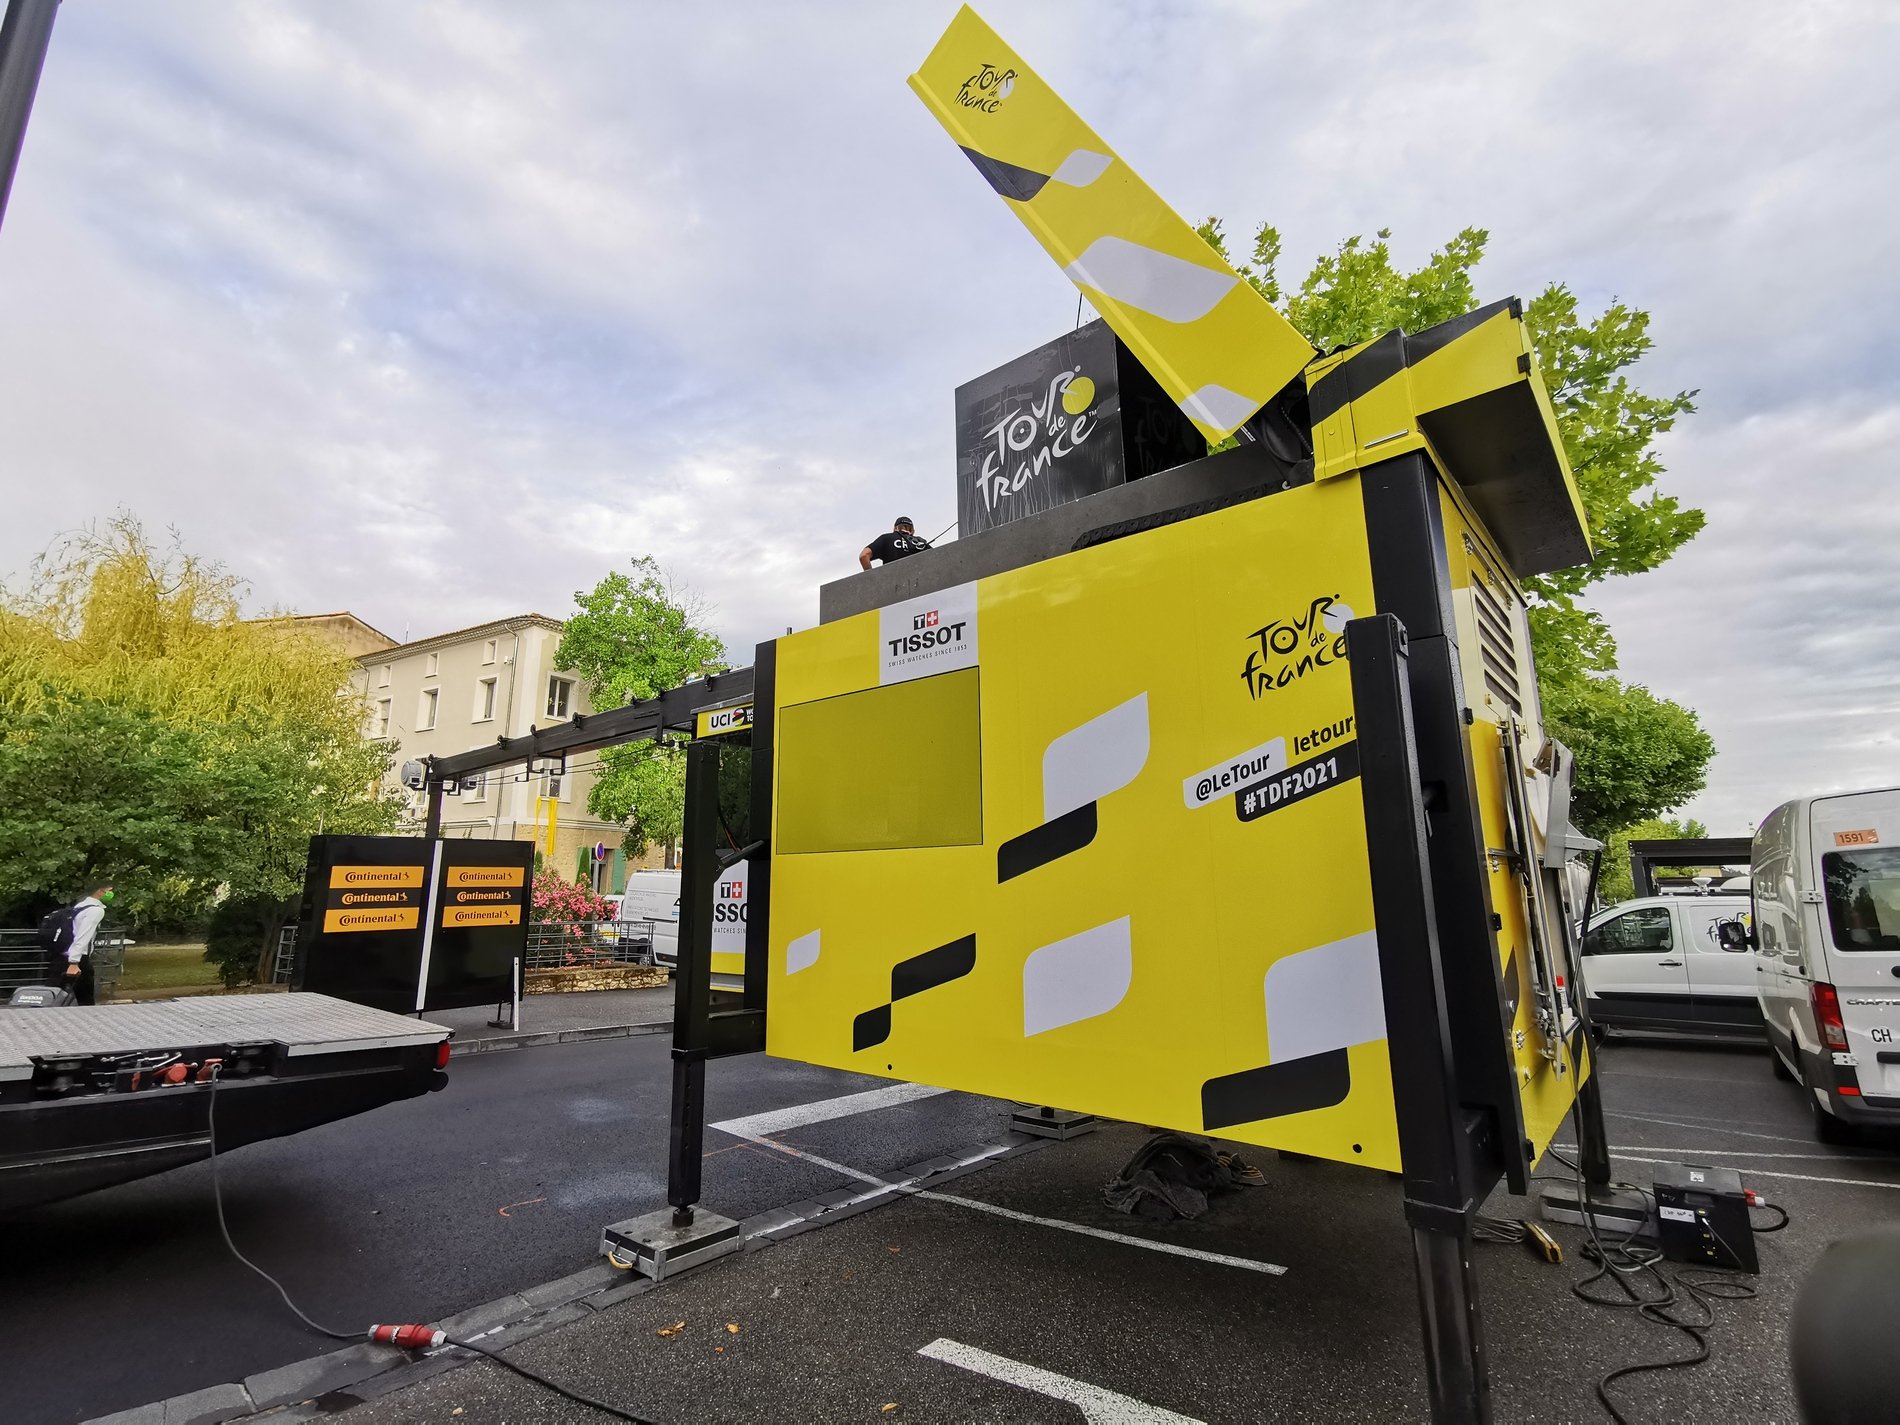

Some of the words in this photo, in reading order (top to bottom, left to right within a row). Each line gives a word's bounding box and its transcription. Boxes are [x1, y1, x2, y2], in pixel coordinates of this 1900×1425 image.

[1048, 413, 1067, 438] de
[888, 621, 967, 657] TISSOT
[1311, 630, 1326, 648] de
[888, 658, 906, 668] SWISS
[907, 652, 933, 663] WATCHES
[934, 647, 952, 657] SINCE
[954, 643, 968, 653] 1853
[711, 713, 731, 728] UCI
[1195, 752, 1271, 802] @LeTour
[1243, 756, 1339, 816] #TDF2021
[1839, 832, 1864, 844] 1591
[345, 871, 401, 883] Continental
[459, 871, 506, 882] Continental
[341, 892, 399, 905] Continental
[456, 890, 504, 903] Continental
[339, 913, 397, 926] Continental
[455, 910, 503, 922] Continental
[1846, 998, 1900, 1006] CRAFTE
[1871, 1028, 1893, 1043] CH
